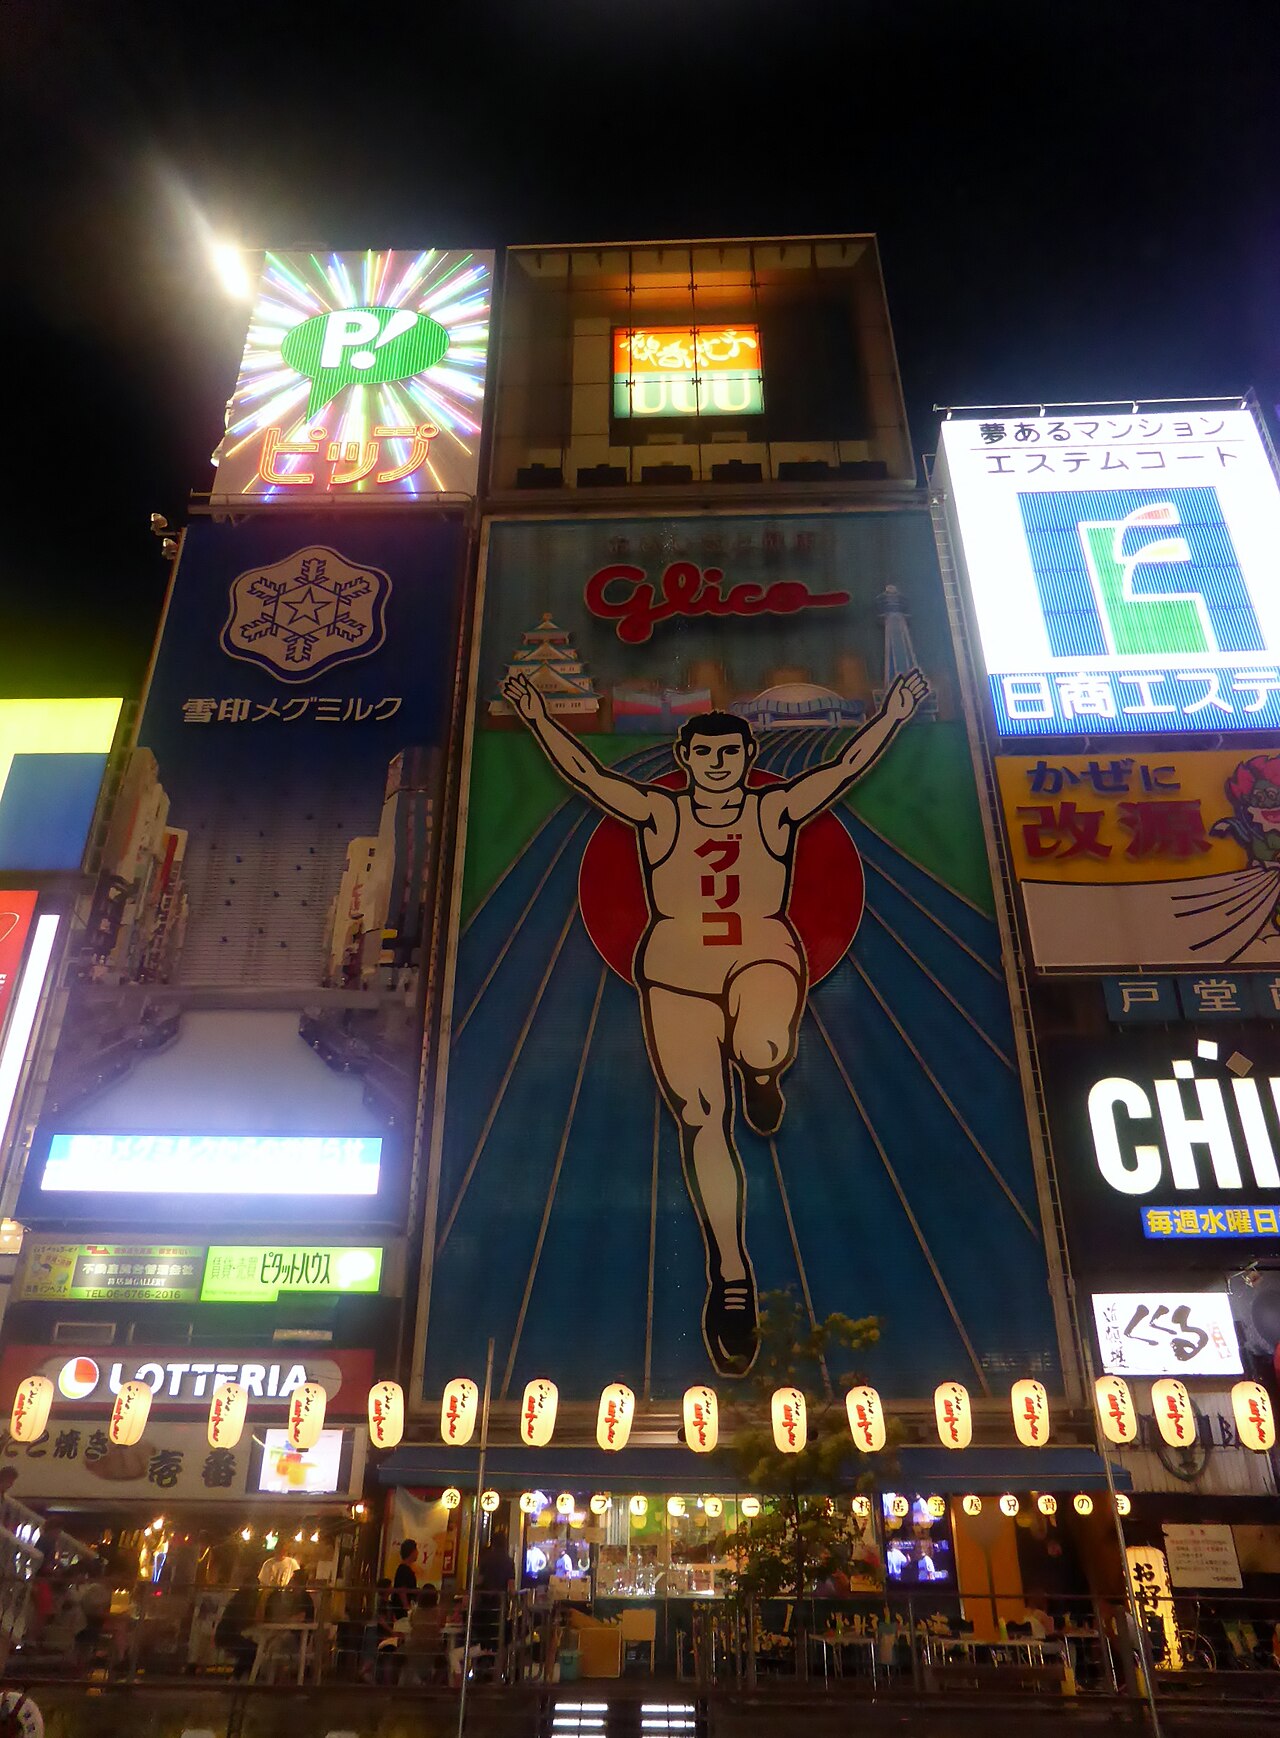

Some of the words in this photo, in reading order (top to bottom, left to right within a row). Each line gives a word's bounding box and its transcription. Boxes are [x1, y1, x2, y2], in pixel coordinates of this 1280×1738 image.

[978, 416, 1225, 444] 夢あるマンション
[258, 424, 440, 485] ピップ
[985, 446, 1238, 473] エステムコート
[584, 561, 851, 644] Glico
[181, 697, 403, 723] 雪印メグミルク
[1002, 671, 1280, 720] 日商エステ
[1026, 758, 1181, 793] かぜに
[1015, 798, 1213, 859] 改源
[693, 833, 743, 946] グリコ
[1118, 978, 1280, 1013] 戸堂
[260, 1251, 331, 1286] ピタットハウス
[108, 1362, 309, 1398] LOTTERIA
